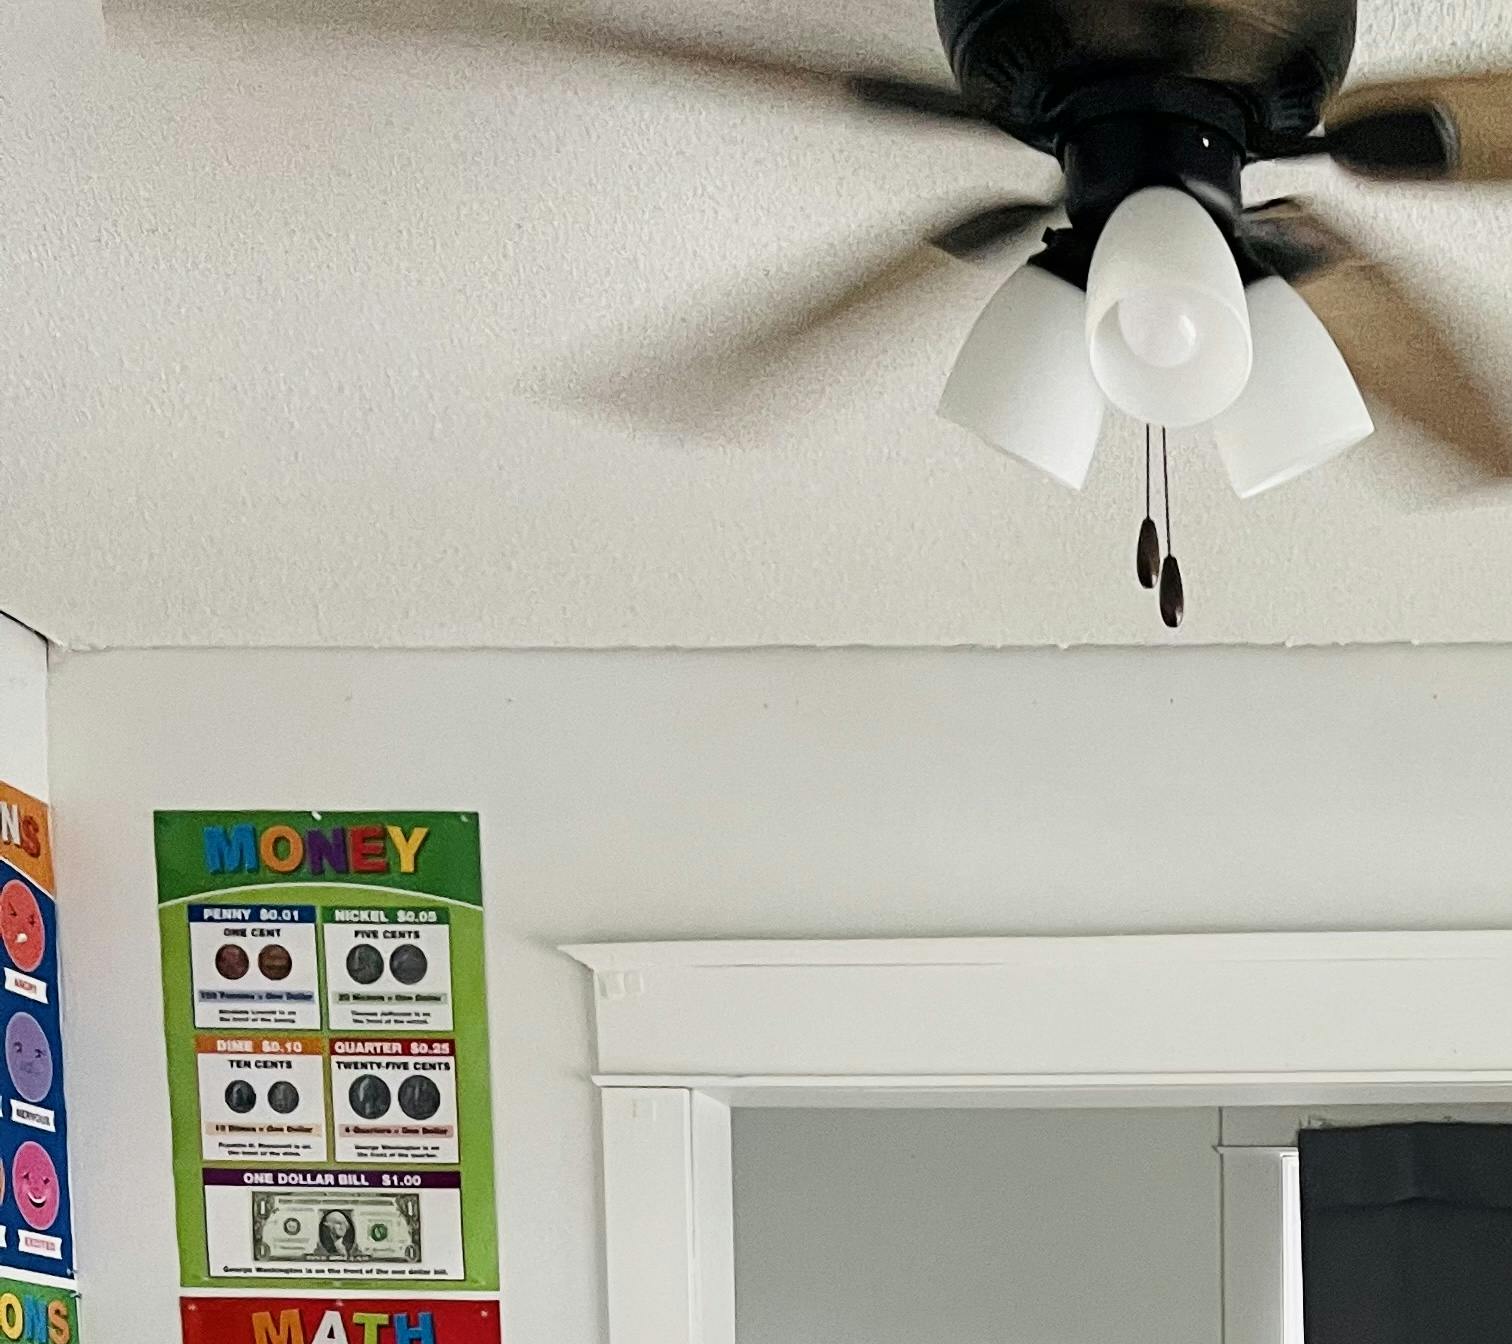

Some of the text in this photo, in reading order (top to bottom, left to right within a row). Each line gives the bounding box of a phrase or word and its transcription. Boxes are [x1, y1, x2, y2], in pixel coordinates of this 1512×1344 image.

[203, 824, 430, 874] MONEY
[204, 908, 298, 920] PENNY $0.01
[335, 909, 389, 922] NICKEL
[223, 928, 281, 937] ONE CENT
[354, 930, 420, 939] FIVE CENTS
[217, 1040, 302, 1052] DIME $0.10
[334, 1042, 450, 1054] QUARTER $0.25
[228, 1060, 292, 1069] TEN CENTS
[336, 1061, 450, 1071] TWENTY-FIVE CENTS
[243, 1174, 421, 1186] ONE DOLLAR BILL $1.00
